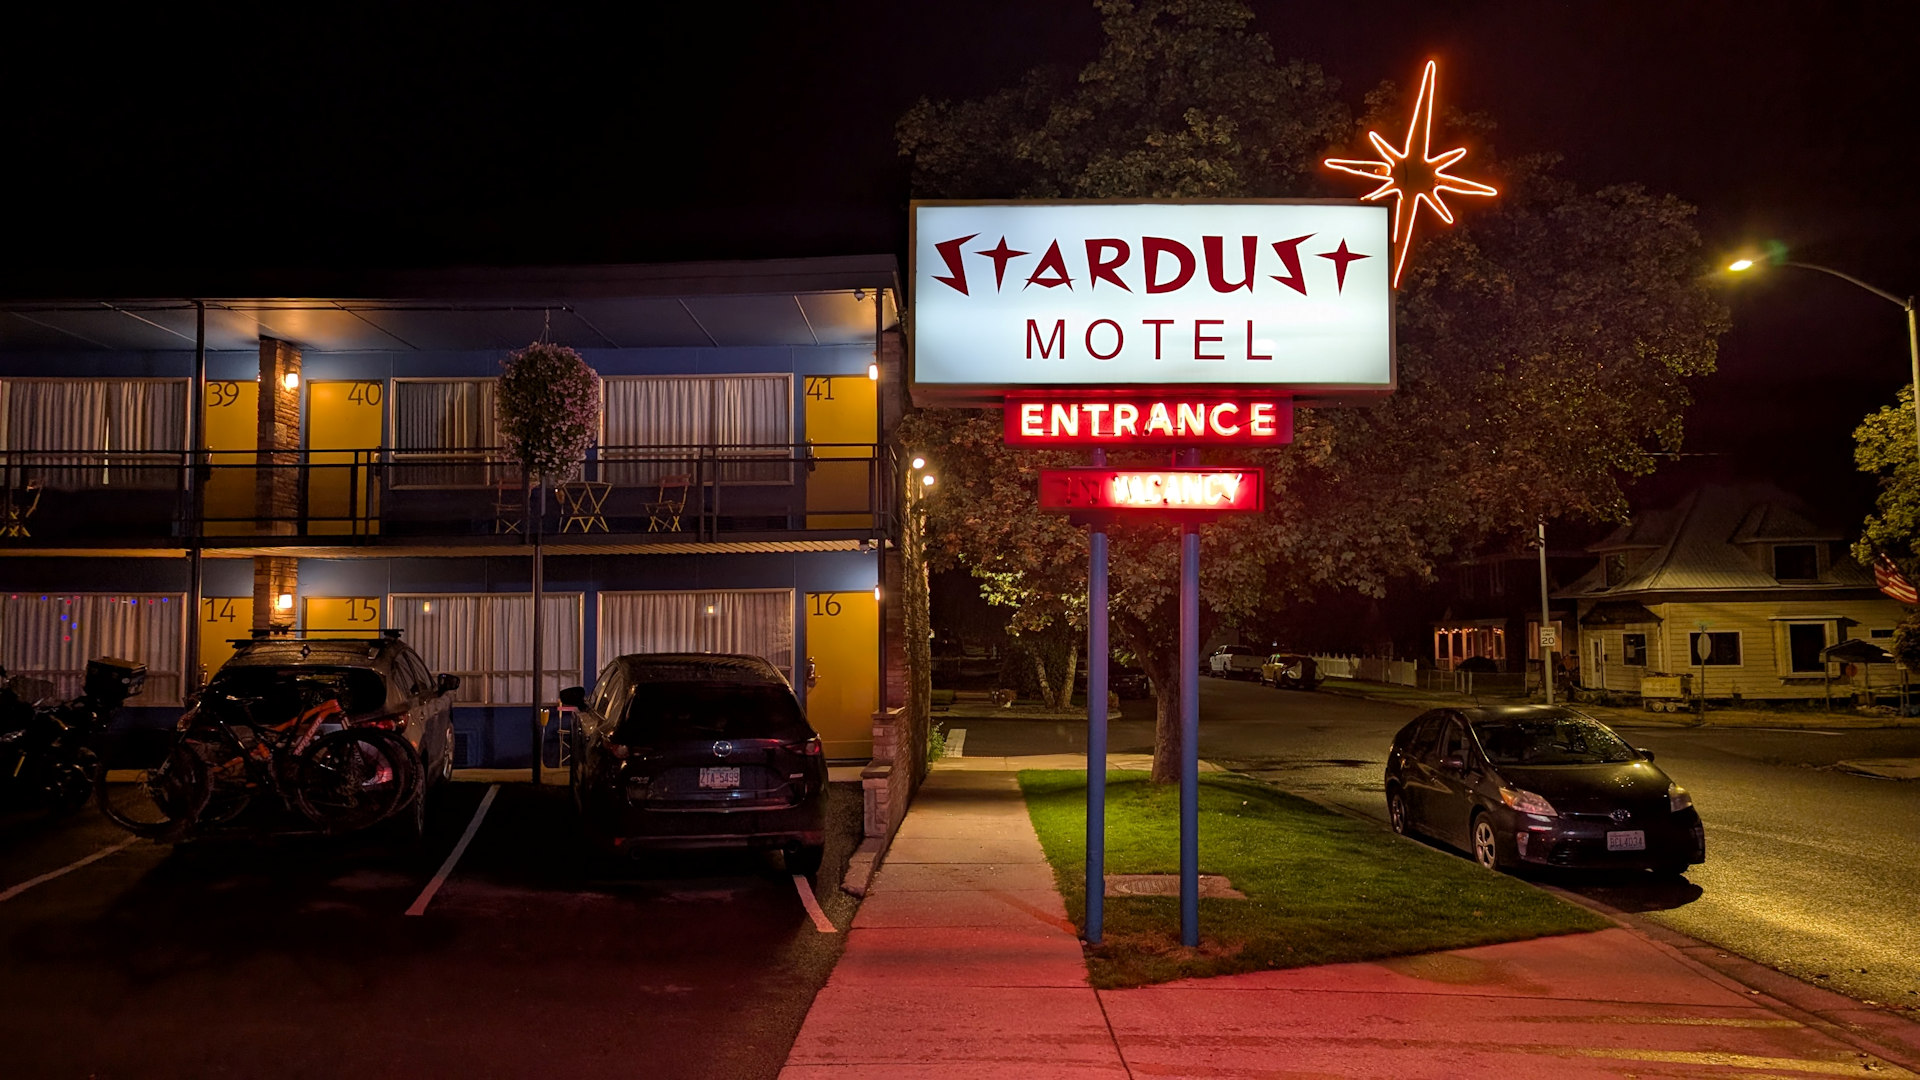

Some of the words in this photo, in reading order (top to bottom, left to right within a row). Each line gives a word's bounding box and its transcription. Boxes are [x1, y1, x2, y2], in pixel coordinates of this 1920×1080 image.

[931, 232, 1374, 297] STARDUST
[1025, 319, 1273, 361] MOTEL
[208, 381, 240, 407] 39
[347, 381, 382, 406] 40
[806, 376, 835, 401] 41
[1021, 402, 1277, 438] ENTRANCE
[204, 597, 237, 623] 14
[345, 597, 377, 622] 15
[811, 593, 842, 617] 16
[1541, 637, 1555, 645] 20
